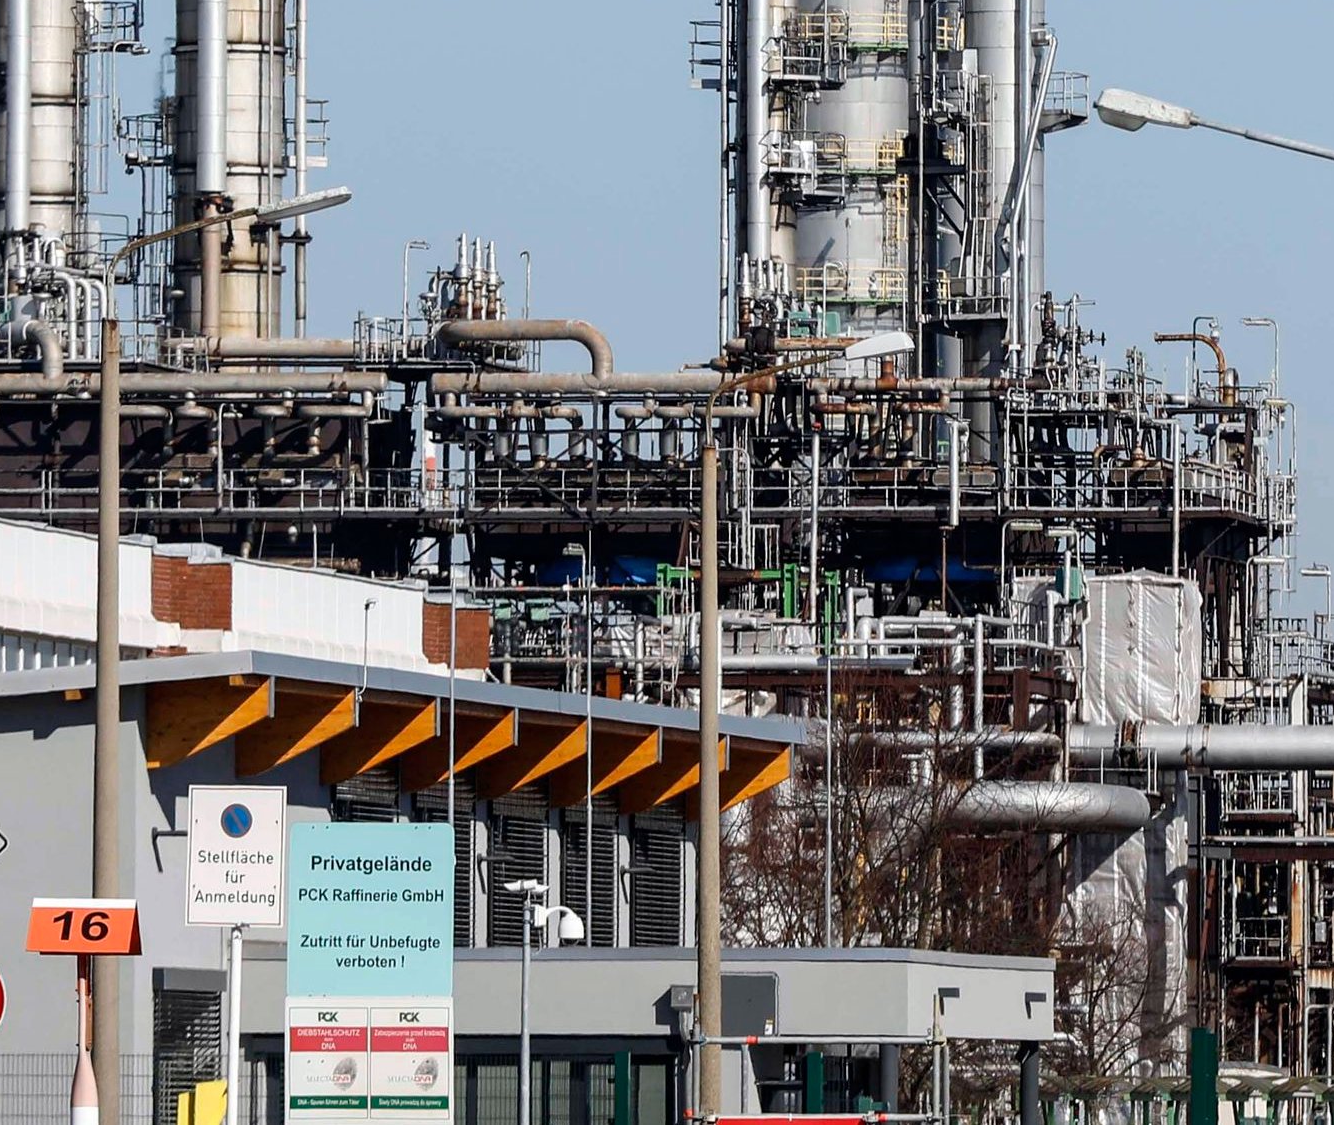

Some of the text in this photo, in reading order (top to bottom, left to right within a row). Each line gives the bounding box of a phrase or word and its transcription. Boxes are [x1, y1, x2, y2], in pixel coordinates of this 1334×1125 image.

[198, 850, 274, 865] Stellfläche
[310, 855, 432, 875] Privatgelände
[225, 870, 246, 884] für
[195, 889, 276, 907] Anmeldung
[298, 888, 444, 902] PCK Raffinerie GmbH
[53, 911, 110, 942] 16
[300, 935, 441, 952] Zutritt für Unbefugte
[336, 955, 397, 968] verboten
[317, 1011, 339, 1023] PCK
[399, 1011, 420, 1023] PCK
[297, 1028, 361, 1037] DIEBSTAHLSCHUTZ
[321, 1042, 336, 1050] DNA
[402, 1043, 417, 1051] DNA
